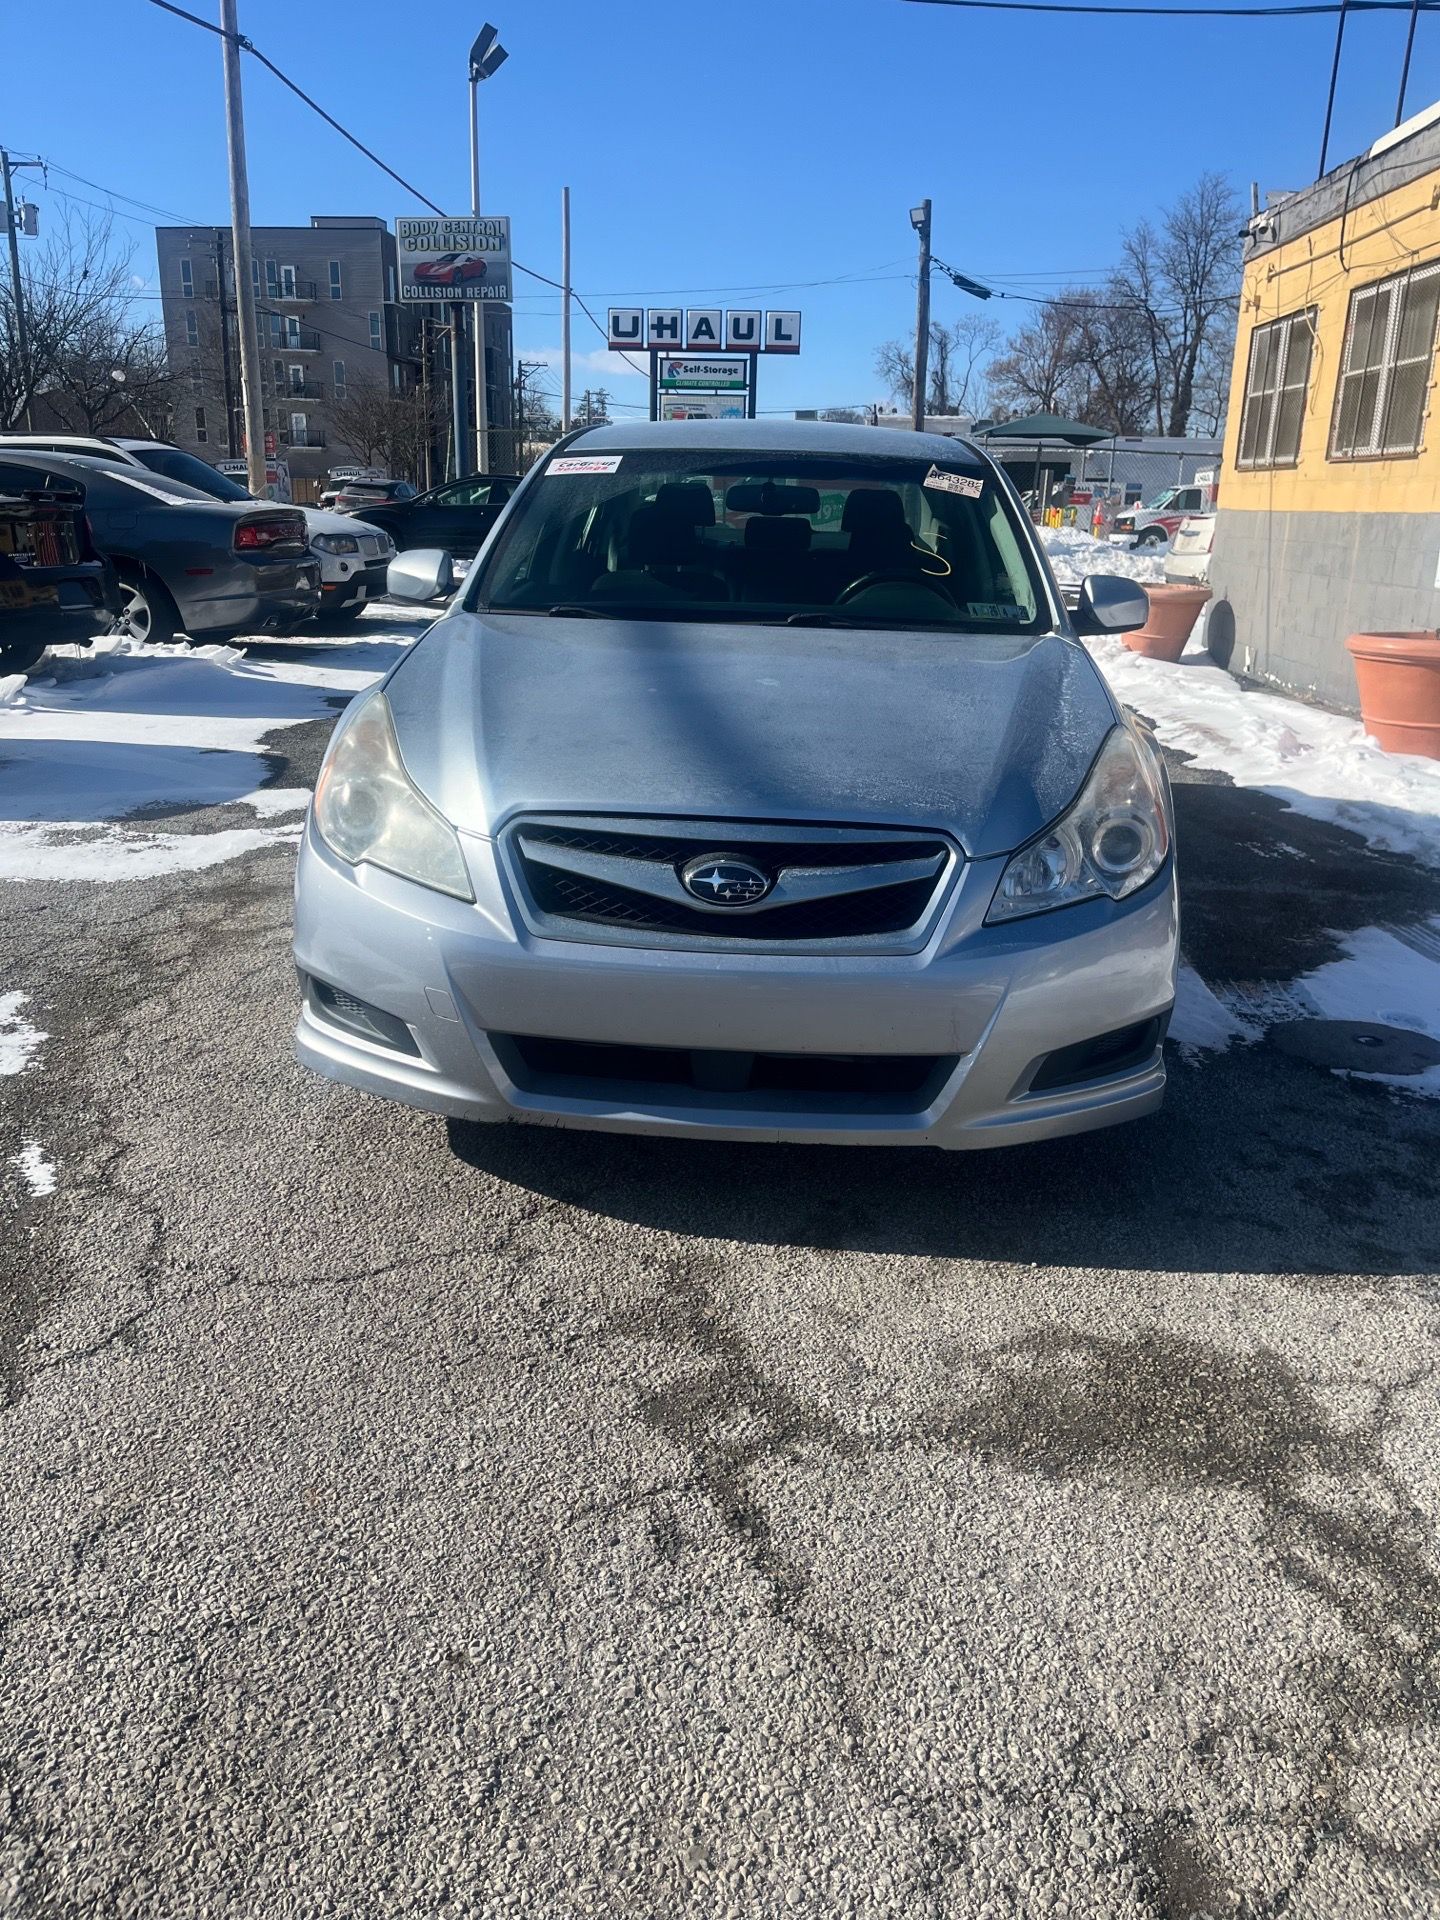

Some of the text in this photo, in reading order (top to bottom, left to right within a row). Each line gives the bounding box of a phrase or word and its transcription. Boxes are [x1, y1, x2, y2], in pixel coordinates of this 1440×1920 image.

[401, 220, 504, 238] BODY CENTRAL
[404, 235, 501, 251] COLLISION
[403, 285, 507, 298] COLLISION REPAIR
[683, 364, 739, 375] Self-Storage
